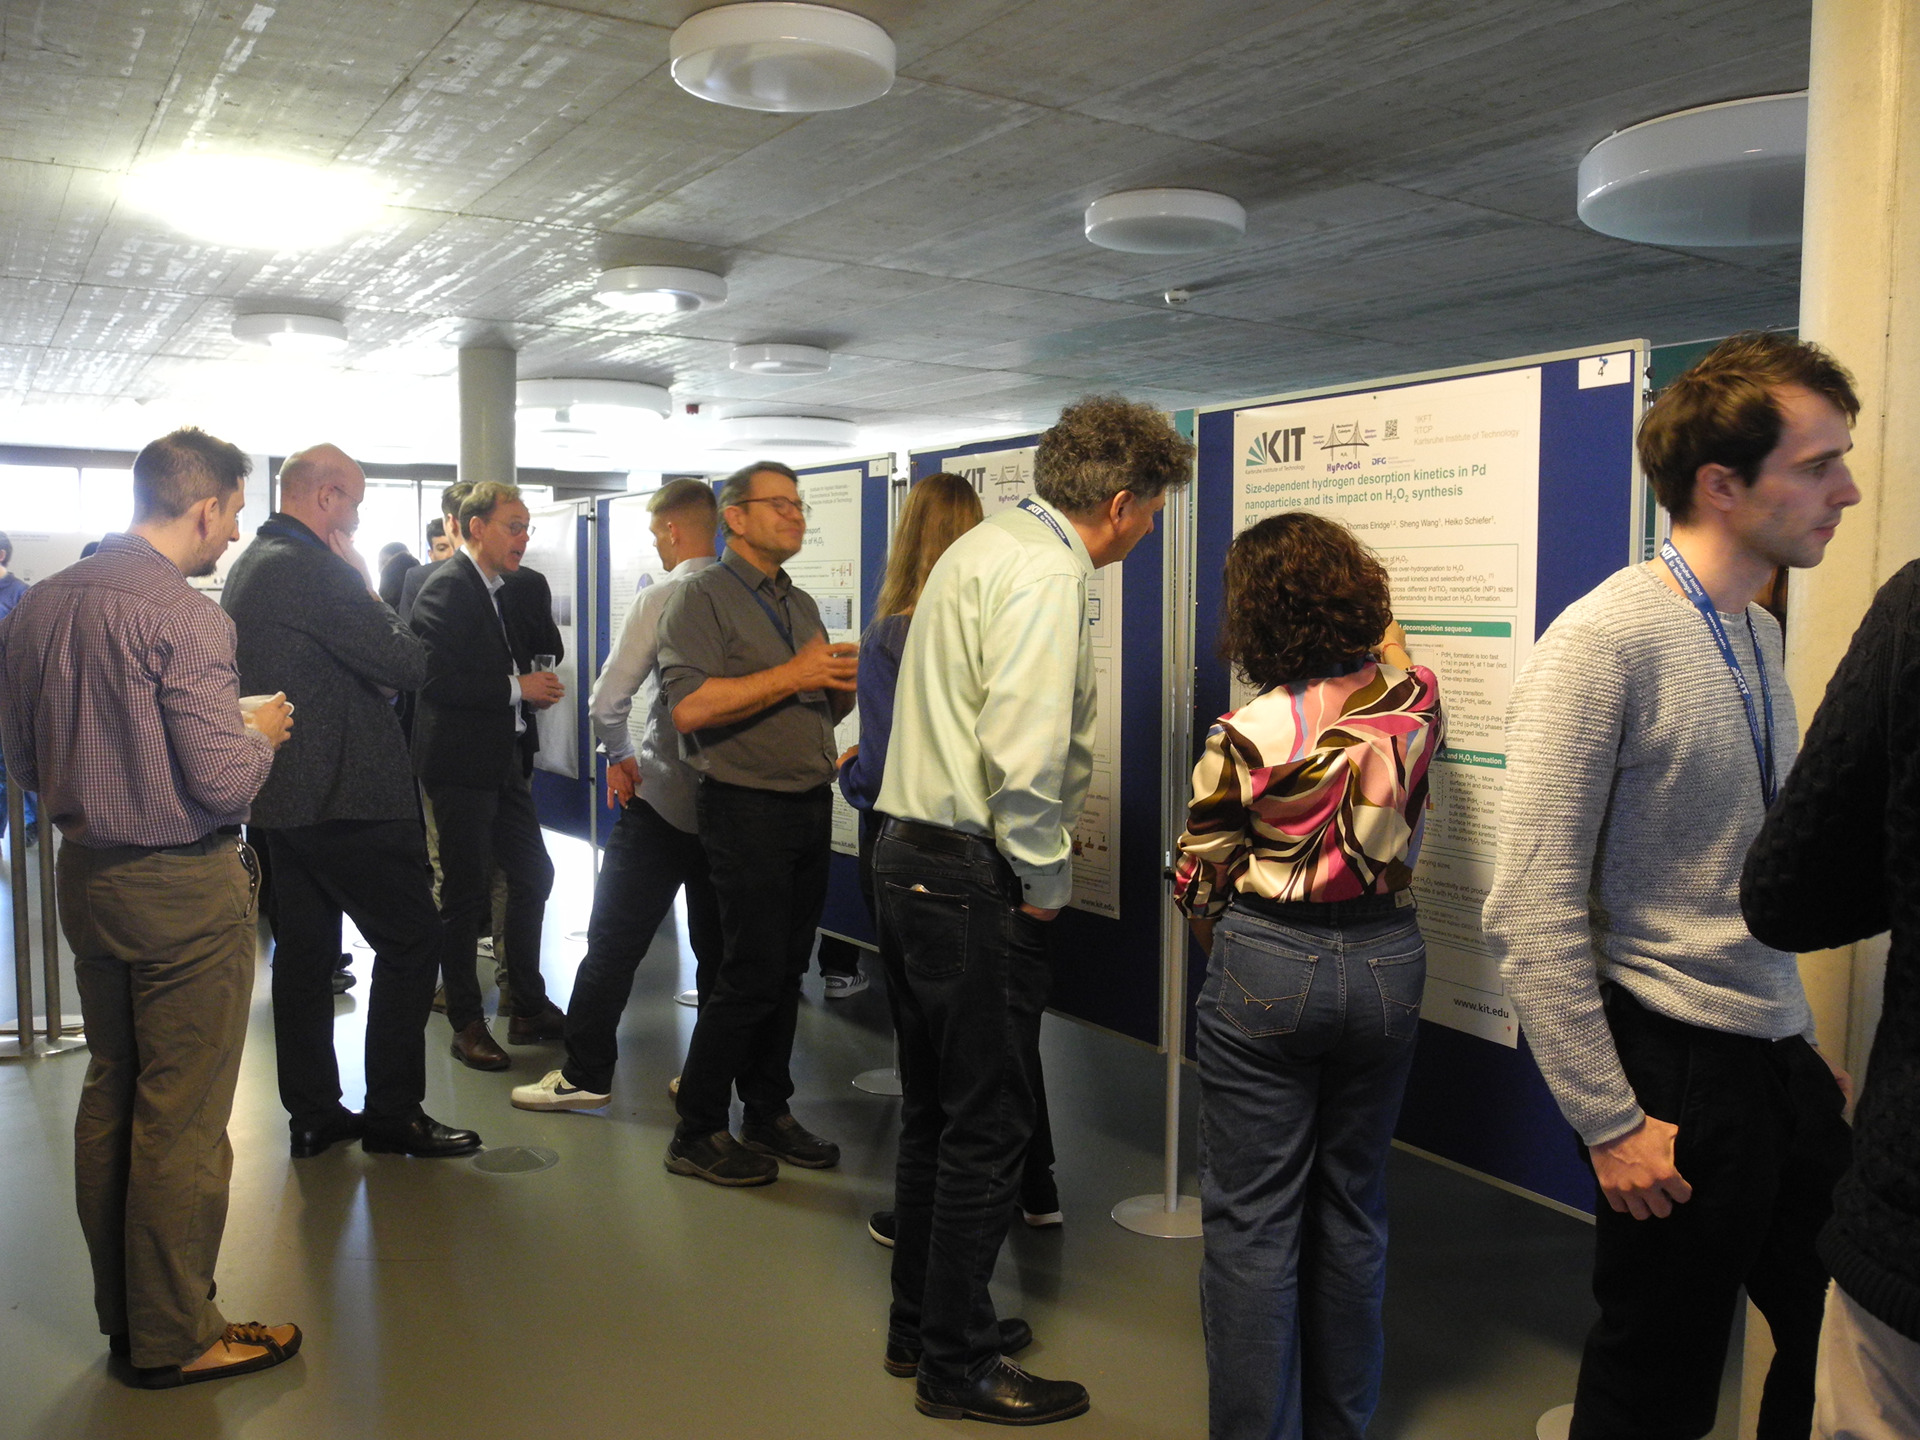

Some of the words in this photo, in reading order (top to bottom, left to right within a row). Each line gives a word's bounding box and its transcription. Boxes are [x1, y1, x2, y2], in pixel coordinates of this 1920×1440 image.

[1597, 366, 1604, 377] 4
[1414, 436, 1444, 446] Karlsruhe
[1446, 434, 1470, 442] Institute
[1482, 428, 1520, 438] Technology
[1267, 427, 1307, 464] KIT
[1245, 480, 1310, 494] Size-dependent
[1312, 477, 1355, 490] hydrogen
[1357, 471, 1411, 487] desorption
[1413, 467, 1455, 481] kinetics
[1458, 466, 1468, 476] in
[1471, 463, 1486, 477] Pd
[1244, 496, 1302, 511] nanoparticles
[1304, 496, 1320, 506] and
[1322, 494, 1334, 504] its
[1336, 491, 1368, 506] impact
[1370, 492, 1382, 500] on
[1411, 484, 1463, 502] synthesis
[1400, 520, 1418, 530] Sheng
[1444, 518, 1464, 526] Heiko
[1400, 564, 1444, 574] over-hydrogenation
[1672, 566, 1693, 594] Technologie
[1450, 586, 1480, 594] nanoparticle
[1482, 586, 1496, 594] (NP)
[1392, 594, 1426, 602] understanding
[1434, 594, 1452, 602] impact
[1402, 624, 1444, 632] decomposition
[1444, 626, 1472, 634] sequence
[1706, 611, 1727, 651] www.kit.edu
[1737, 677, 1750, 695] KIT
[1442, 688, 1462, 696] Two-step
[1472, 756, 1502, 764] formation
[1448, 818, 1466, 826] Surface
[1478, 830, 1496, 838] kinetics
[1458, 884, 1470, 892] and
[1081, 898, 1115, 912] www.kit.edu
[1453, 998, 1510, 1019] www.kit.edu
